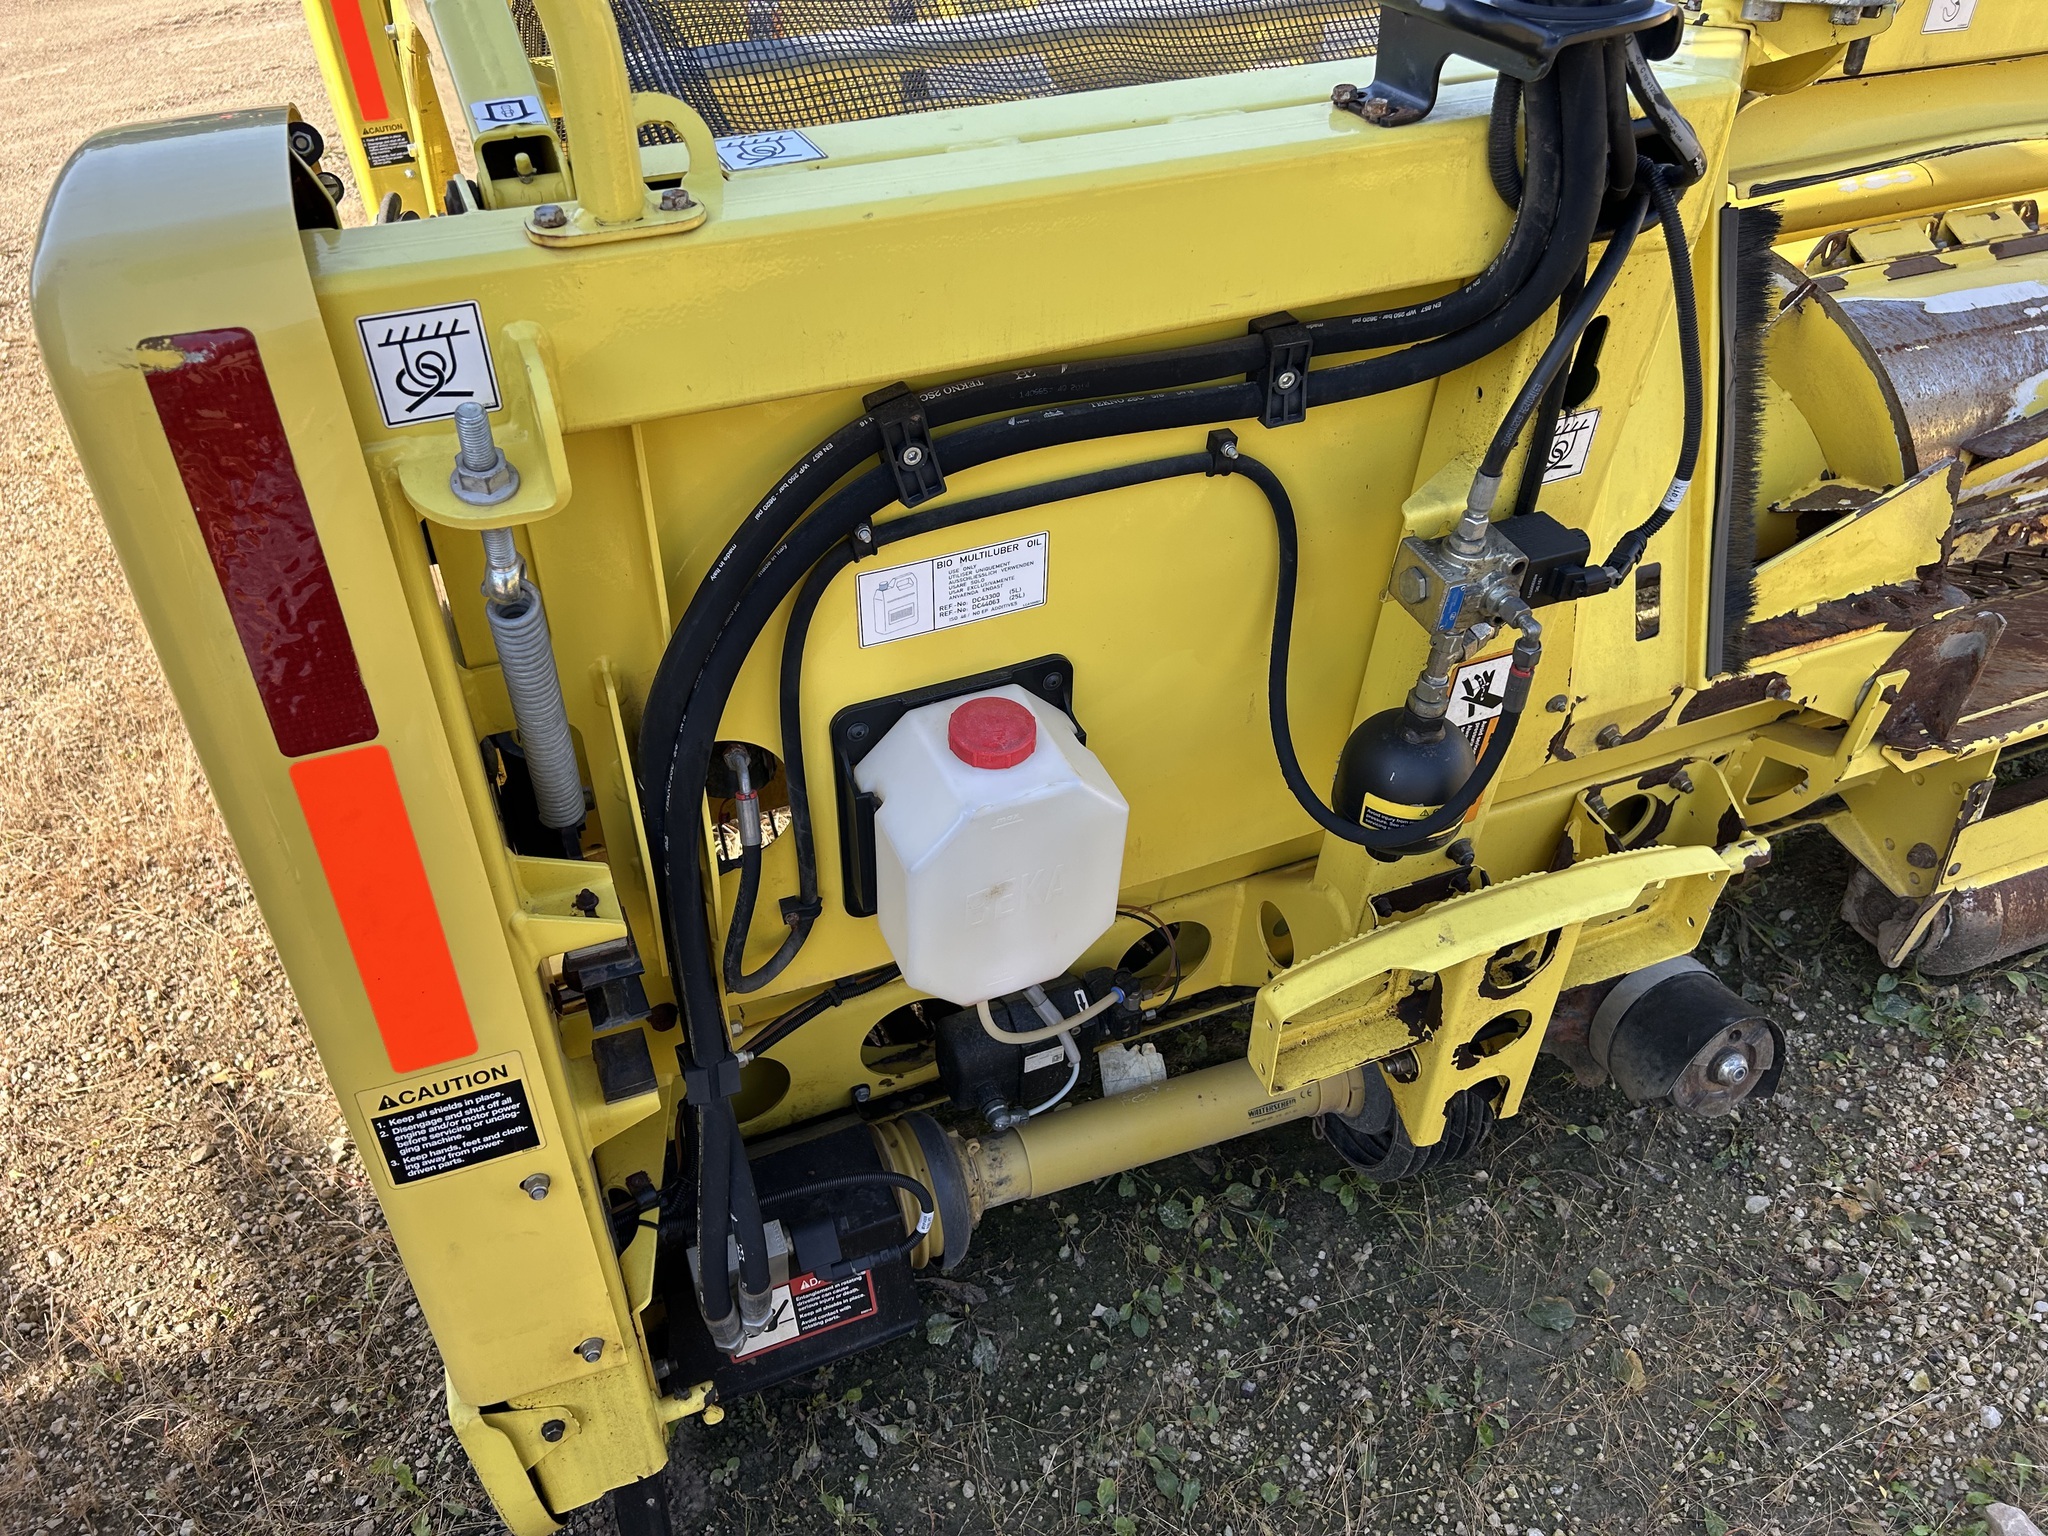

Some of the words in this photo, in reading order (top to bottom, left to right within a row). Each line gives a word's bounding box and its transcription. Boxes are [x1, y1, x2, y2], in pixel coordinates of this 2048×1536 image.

[368, 123, 403, 135] CAUTION
[1405, 308, 1417, 317] WP
[1420, 303, 1433, 314] 857
[1432, 301, 1442, 310] EN
[1351, 317, 1362, 325] psi
[943, 379, 985, 395] TEKNO
[919, 390, 942, 403] 2SC
[859, 419, 869, 428] 16
[811, 450, 824, 463] 857
[822, 442, 834, 454] EN
[799, 463, 811, 475] WP
[787, 472, 800, 485] 250
[778, 481, 790, 494] bar
[762, 495, 777, 512] 3620
[754, 508, 764, 521] psi
[724, 543, 738, 563] made
[757, 561, 772, 578] made
[770, 553, 777, 562] in
[777, 543, 789, 556] Italy
[936, 559, 953, 570] BIO
[959, 543, 1020, 564] MULTILUBER
[1026, 538, 1042, 548] OIL
[718, 559, 726, 570] in
[948, 567, 961, 575] USE
[962, 564, 977, 572] ONLY
[948, 571, 973, 580] UTILISER
[975, 561, 1011, 574] UNIQUEMENT
[948, 570, 998, 585] AUSSCHLIESSLICH
[1001, 560, 1035, 573] VERWENDEN
[709, 567, 722, 582] Italy
[948, 581, 967, 590] USARE
[970, 578, 985, 586] SOLO
[948, 587, 964, 596] USAR
[966, 575, 1015, 591] EXCLUSIVAMENTE
[948, 591, 980, 601] ANVAENDA
[982, 583, 1004, 593] ENDAST
[971, 592, 1001, 604] DC43300
[1009, 586, 1022, 595] (5L)
[971, 598, 1001, 611] DC44063
[1008, 591, 1026, 601] (25L)
[990, 601, 1018, 613] ADDITIVES
[995, 812, 1021, 824] max
[1365, 818, 1388, 830] servicing
[1366, 813, 1388, 826] pressure.
[1367, 808, 1381, 818] Avoid
[1381, 812, 1396, 823] injury
[1396, 817, 1409, 825] from
[398, 1064, 509, 1105] CAUTION
[1300, 1087, 1312, 1099] CE
[376, 1121, 386, 1130] 1.
[388, 1114, 415, 1127] Keep
[416, 1110, 428, 1120] all
[429, 1102, 463, 1117] shields
[465, 1097, 474, 1107] in
[475, 1091, 505, 1105] place.
[380, 1130, 389, 1139] 2.
[391, 1117, 443, 1136] Disengage
[444, 1110, 463, 1121] and
[465, 1103, 486, 1116] shut
[487, 1100, 500, 1110] off
[501, 1096, 513, 1106] all
[394, 1129, 427, 1144] engine
[428, 1118, 461, 1134] and/or
[461, 1111, 490, 1124] motor
[491, 1102, 521, 1117] power
[396, 1135, 428, 1149] before
[429, 1123, 472, 1141] servicing
[473, 1119, 484, 1128] or
[485, 1111, 521, 1126] unclog-
[390, 1159, 400, 1167] 3.
[402, 1151, 428, 1166] Keep
[429, 1143, 462, 1158] hands,
[462, 1137, 481, 1149] feet
[482, 1131, 501, 1142] and
[501, 1125, 529, 1138] cloth-
[399, 1145, 421, 1157] ging
[422, 1133, 466, 1151] machine.
[404, 1160, 420, 1171] ing
[421, 1155, 447, 1170] away
[448, 1149, 471, 1160] from
[472, 1139, 505, 1154] power-
[407, 1165, 436, 1178] driven
[437, 1158, 465, 1172] parts.
[795, 1284, 834, 1302] Entanglement
[840, 1275, 863, 1288] rotating
[796, 1296, 821, 1307] driveline
[832, 1286, 850, 1295] cause
[797, 1302, 819, 1312] serious
[819, 1297, 835, 1307] injury
[842, 1288, 860, 1299] death.
[799, 1310, 815, 1319] Keep
[822, 1301, 843, 1312] shields
[849, 1293, 866, 1303] place.
[801, 1317, 818, 1326] Avoid
[817, 1310, 839, 1321] contact
[839, 1305, 852, 1313] with
[802, 1319, 824, 1332] rotating
[824, 1314, 841, 1326] parts.
